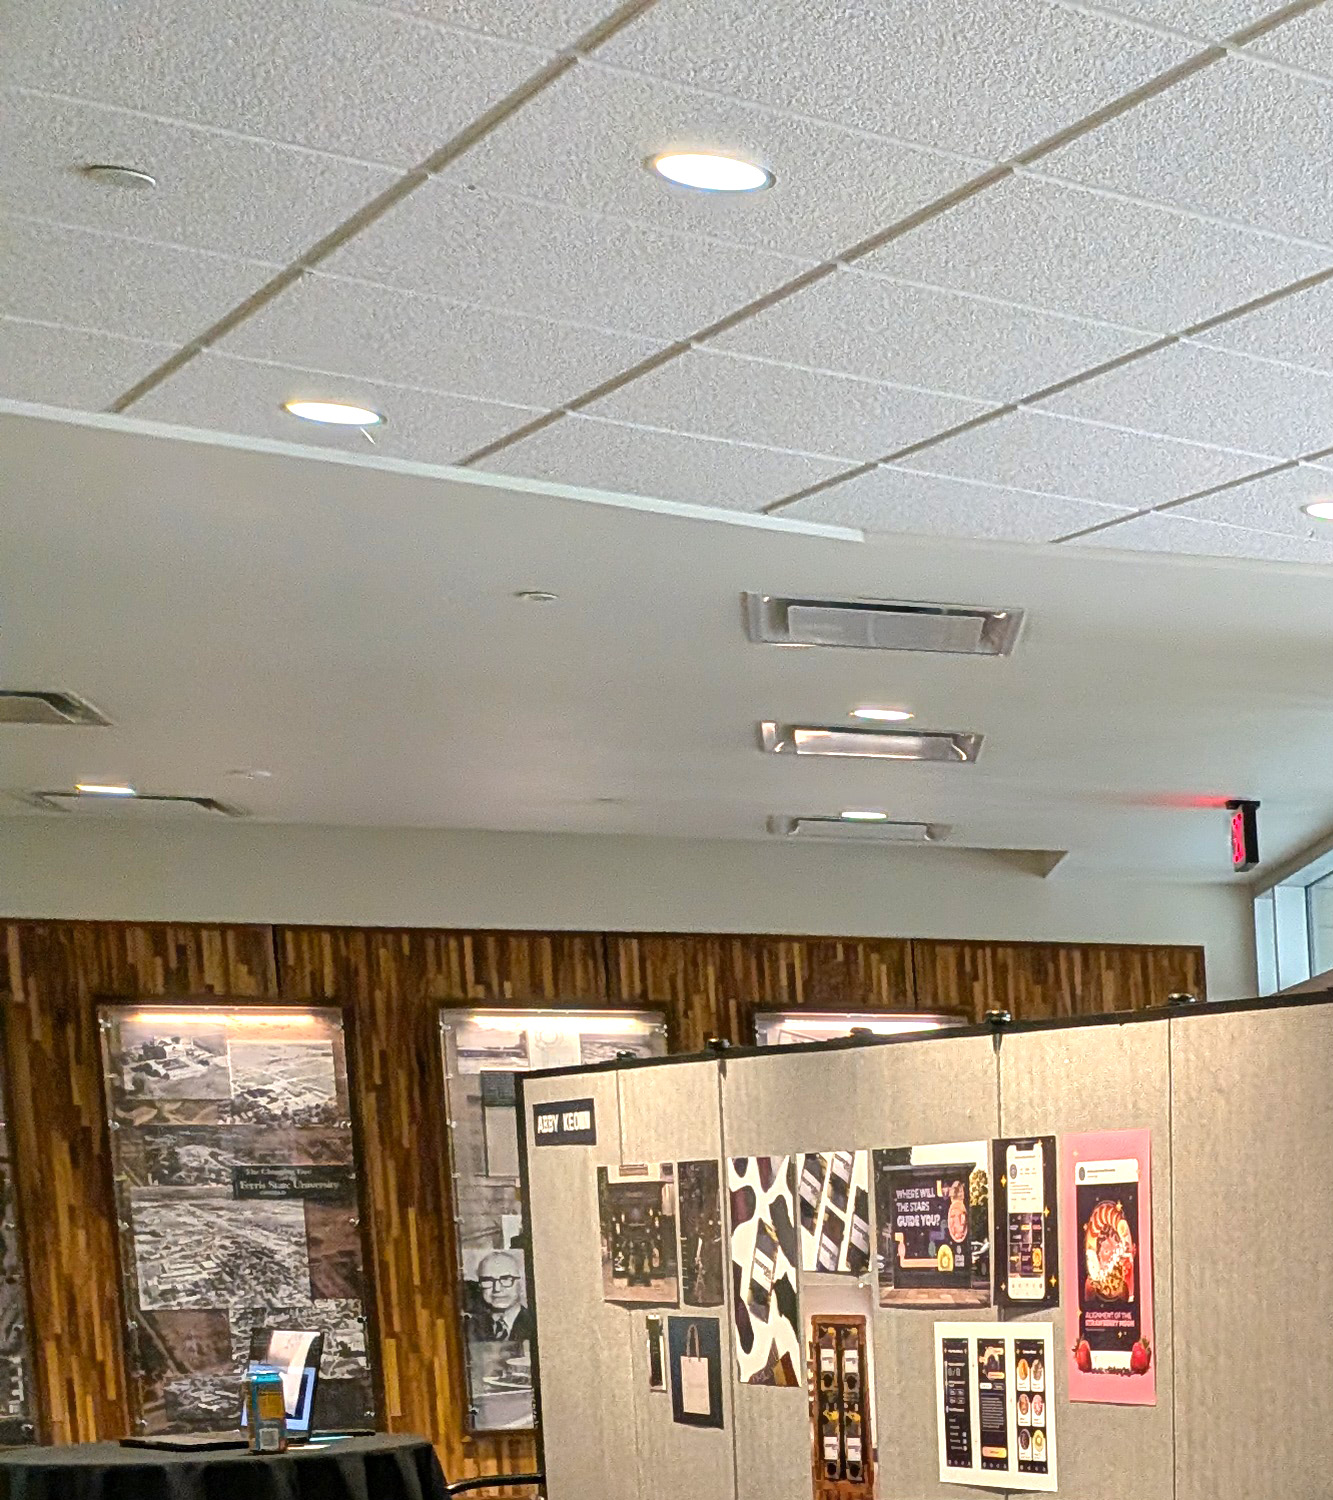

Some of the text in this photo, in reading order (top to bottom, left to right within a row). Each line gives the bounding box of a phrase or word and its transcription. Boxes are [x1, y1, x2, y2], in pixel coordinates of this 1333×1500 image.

[537, 1110, 591, 1135] ABBY KEO
[896, 1202, 909, 1212] THE
[897, 1215, 920, 1227] GUIDE
